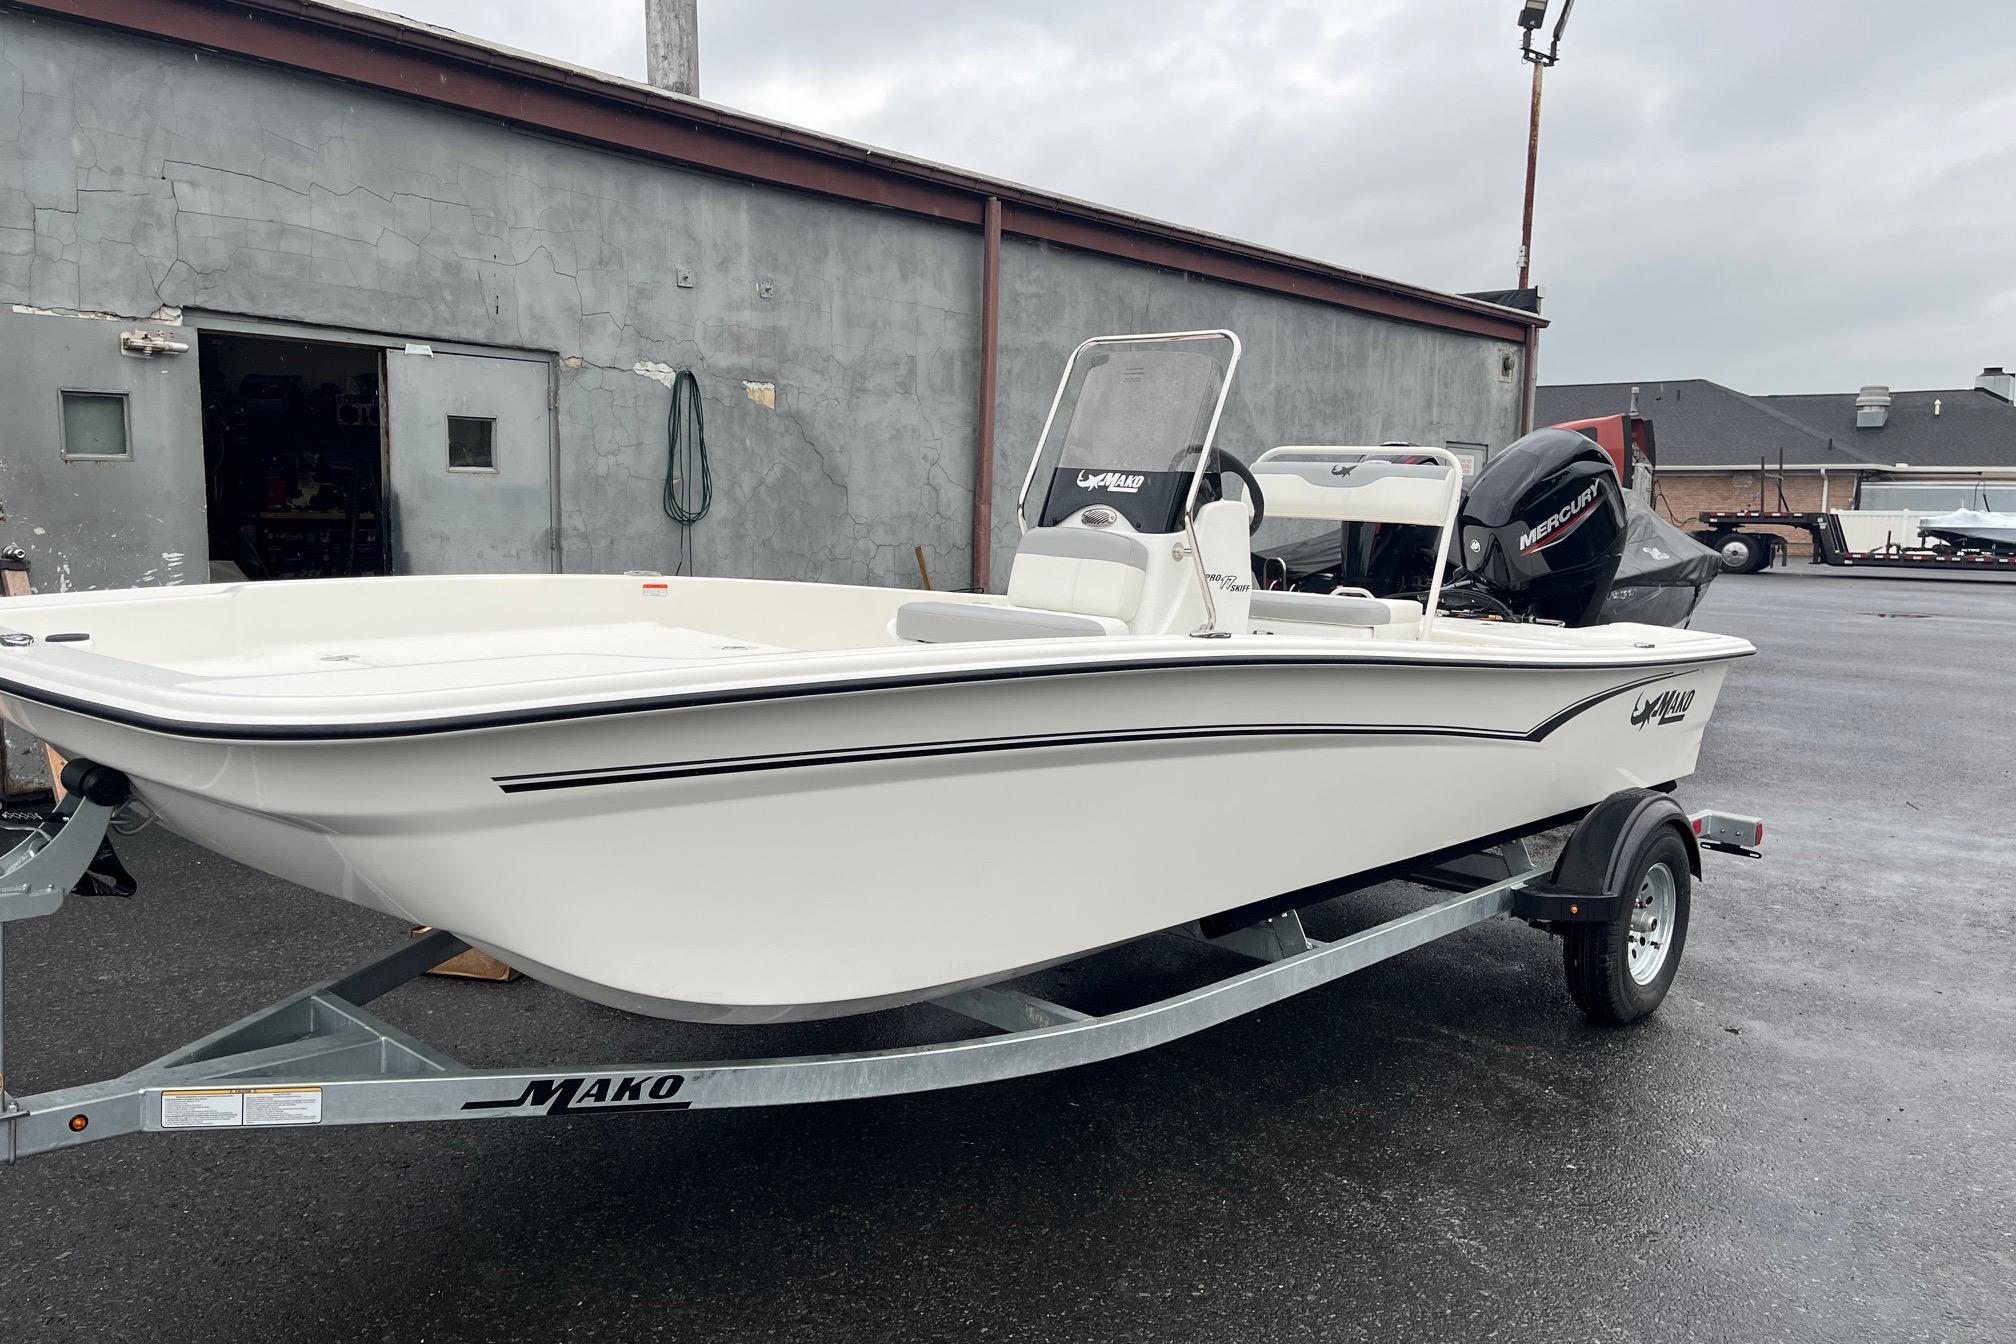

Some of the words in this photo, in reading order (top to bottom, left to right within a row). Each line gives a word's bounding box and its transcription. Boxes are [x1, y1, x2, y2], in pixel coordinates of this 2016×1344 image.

[1098, 472, 1144, 493] MAKO
[1519, 478, 1600, 551] MERCURY
[1205, 573, 1222, 582] PRO
[1230, 584, 1251, 592] SKIFF
[1656, 689, 1696, 726] MAKO
[461, 1074, 692, 1116] MAKO
